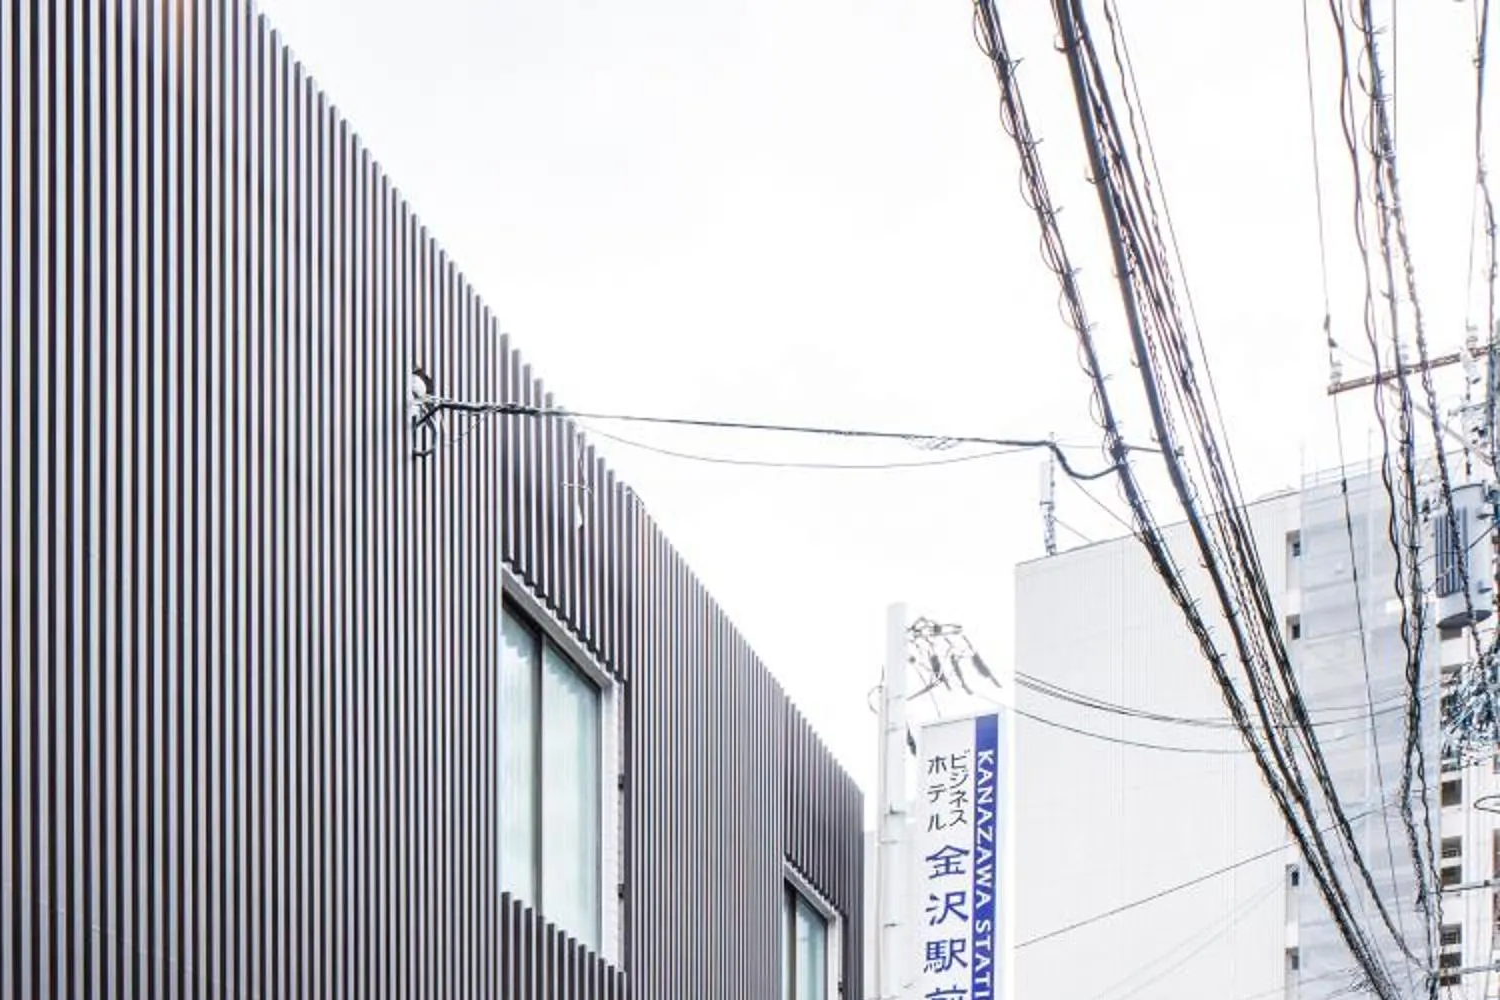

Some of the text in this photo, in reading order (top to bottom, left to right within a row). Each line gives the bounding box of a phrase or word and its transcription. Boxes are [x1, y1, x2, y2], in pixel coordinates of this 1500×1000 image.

[927, 755, 947, 832] ホテル
[950, 748, 970, 827] ビジネス
[975, 749, 995, 910] KANAZAWA
